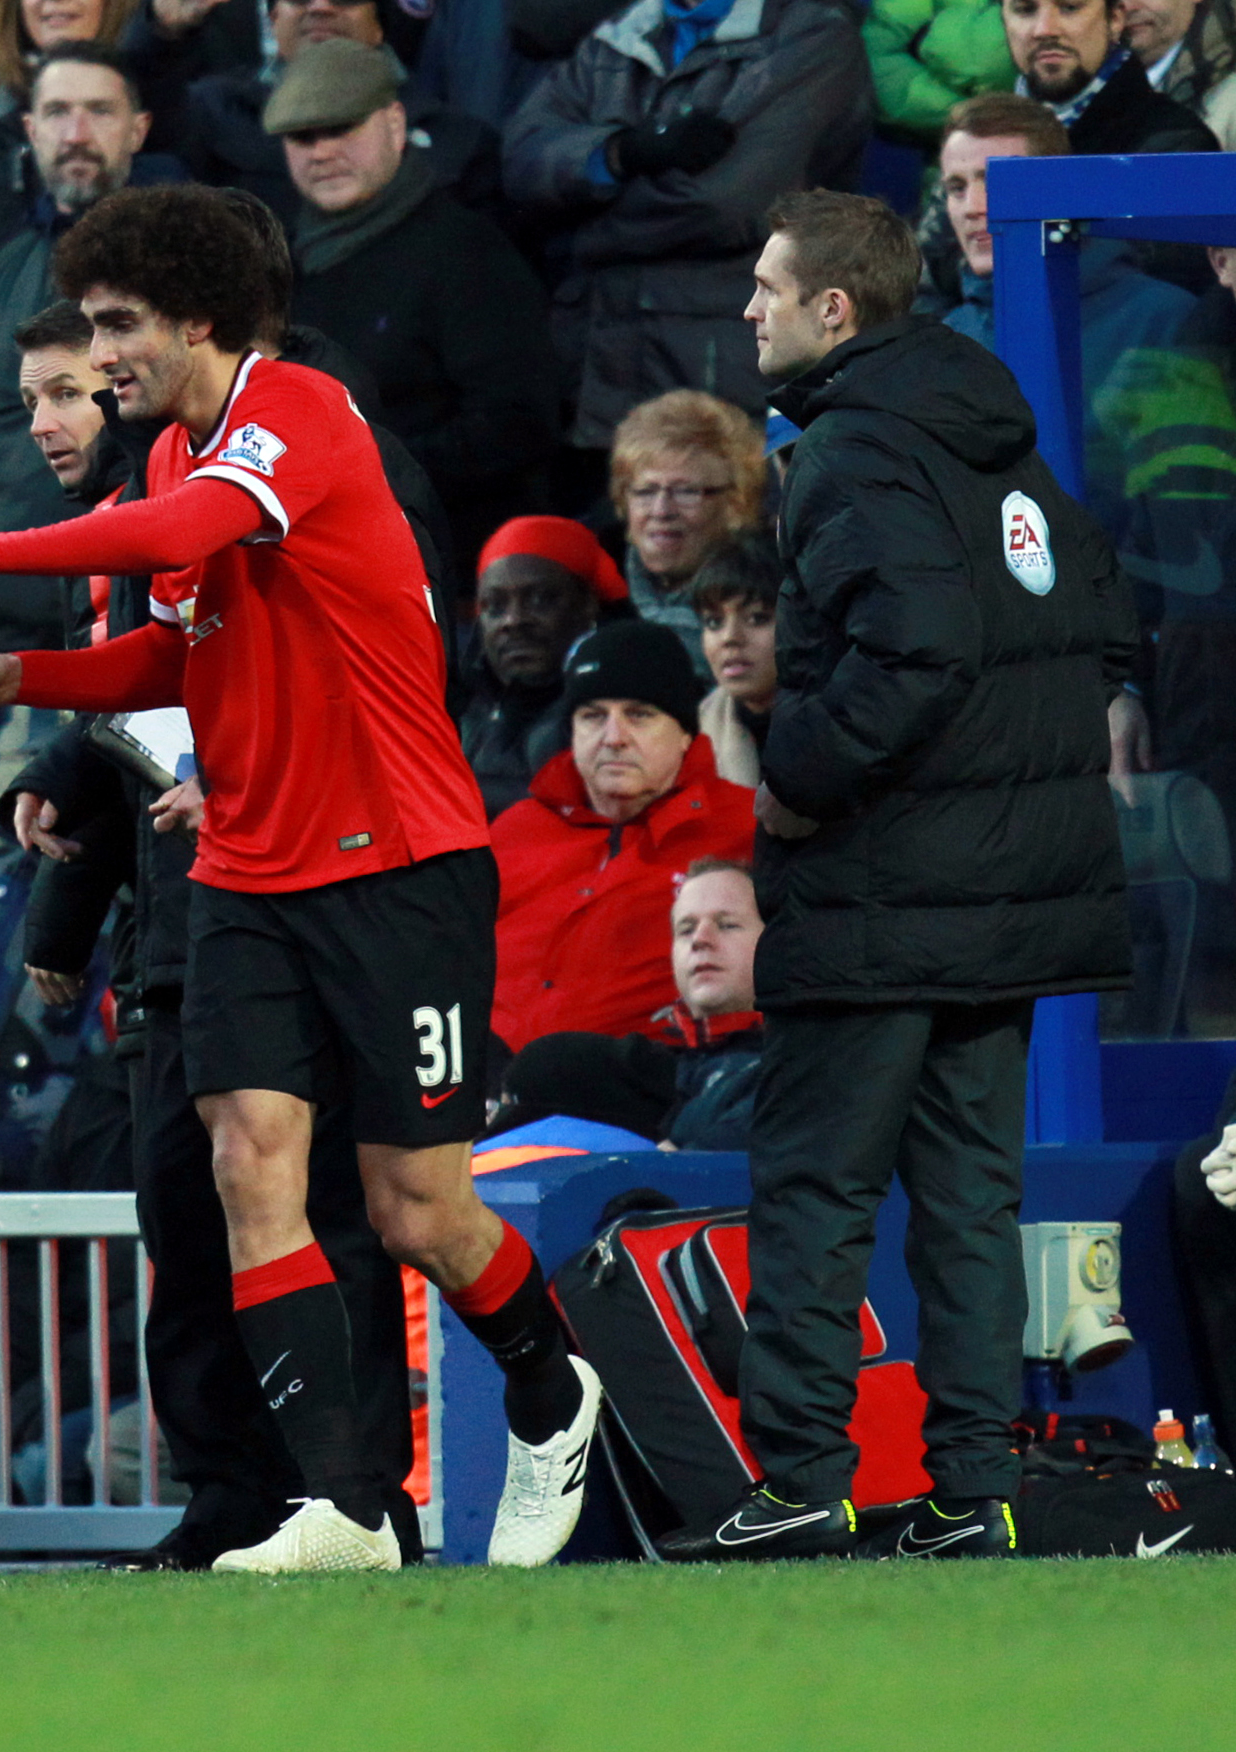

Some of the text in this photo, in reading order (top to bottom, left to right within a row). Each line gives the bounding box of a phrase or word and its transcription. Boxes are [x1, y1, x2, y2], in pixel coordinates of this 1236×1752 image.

[1009, 514, 1042, 551] EA
[1010, 551, 1048, 569] SPORTS
[412, 1002, 463, 1087] 31
